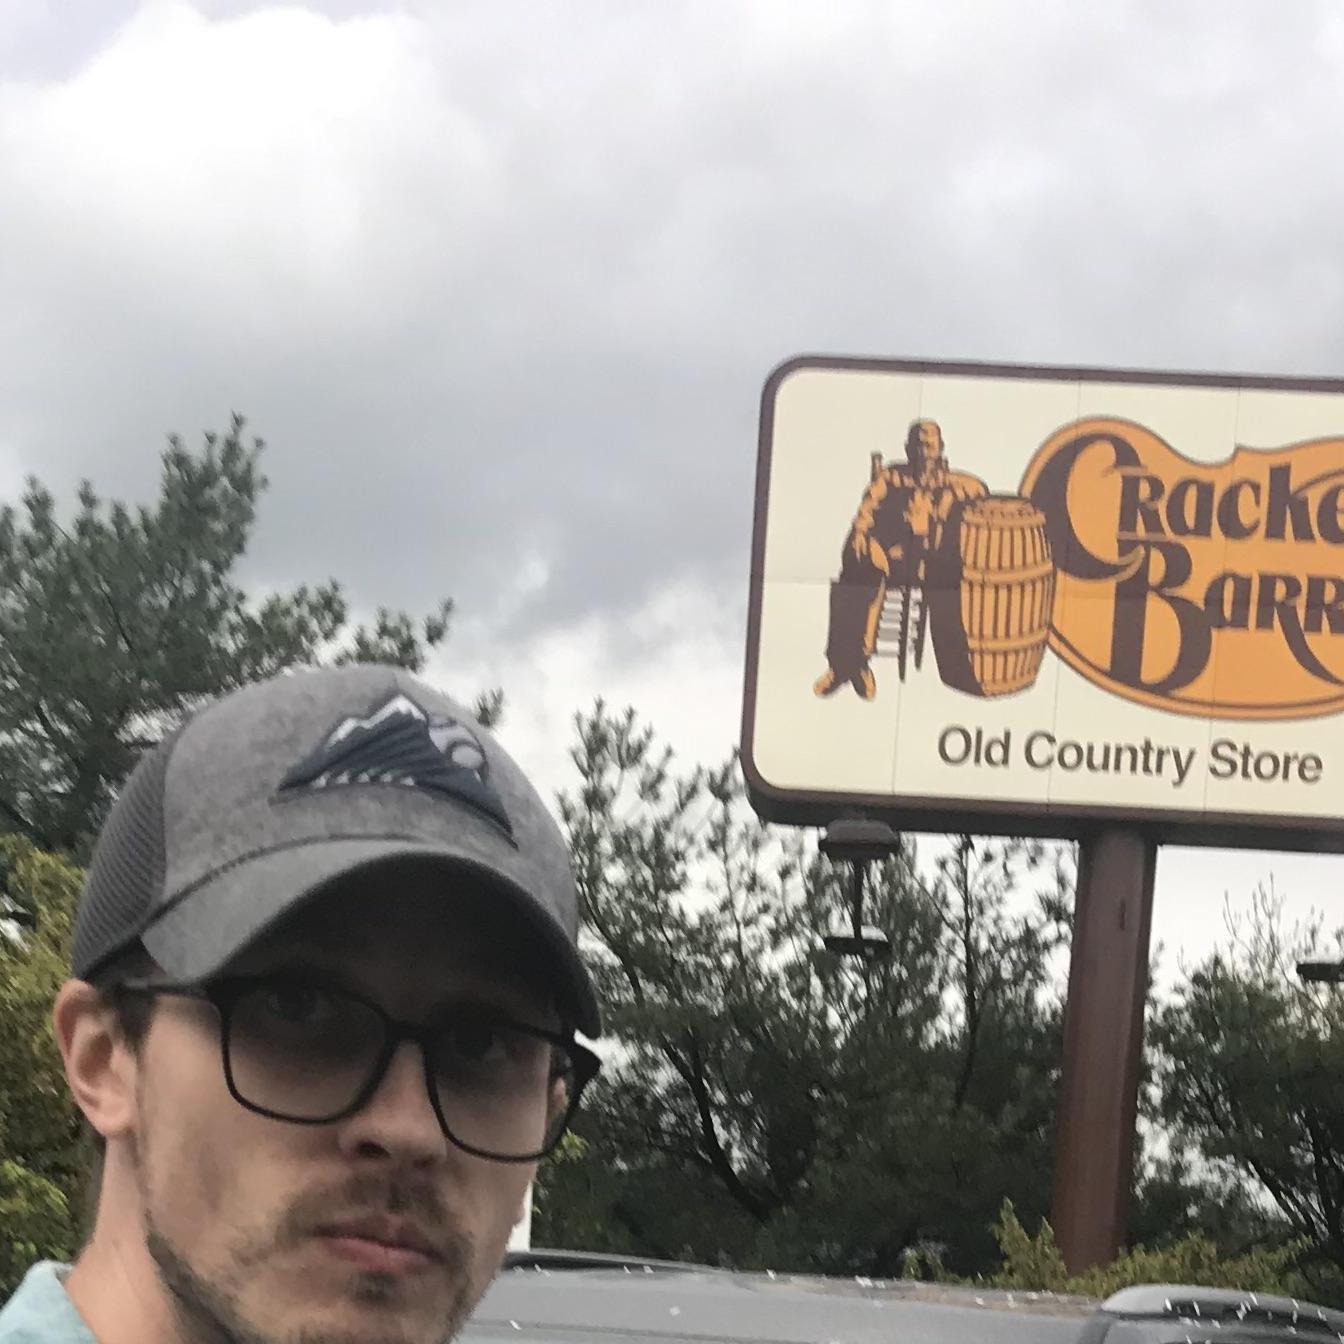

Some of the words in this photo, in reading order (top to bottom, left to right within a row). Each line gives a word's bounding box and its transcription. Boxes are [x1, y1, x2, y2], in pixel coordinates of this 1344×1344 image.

[937, 724, 1011, 768] Old
[1023, 730, 1196, 788] Country
[1208, 738, 1324, 783] Store
